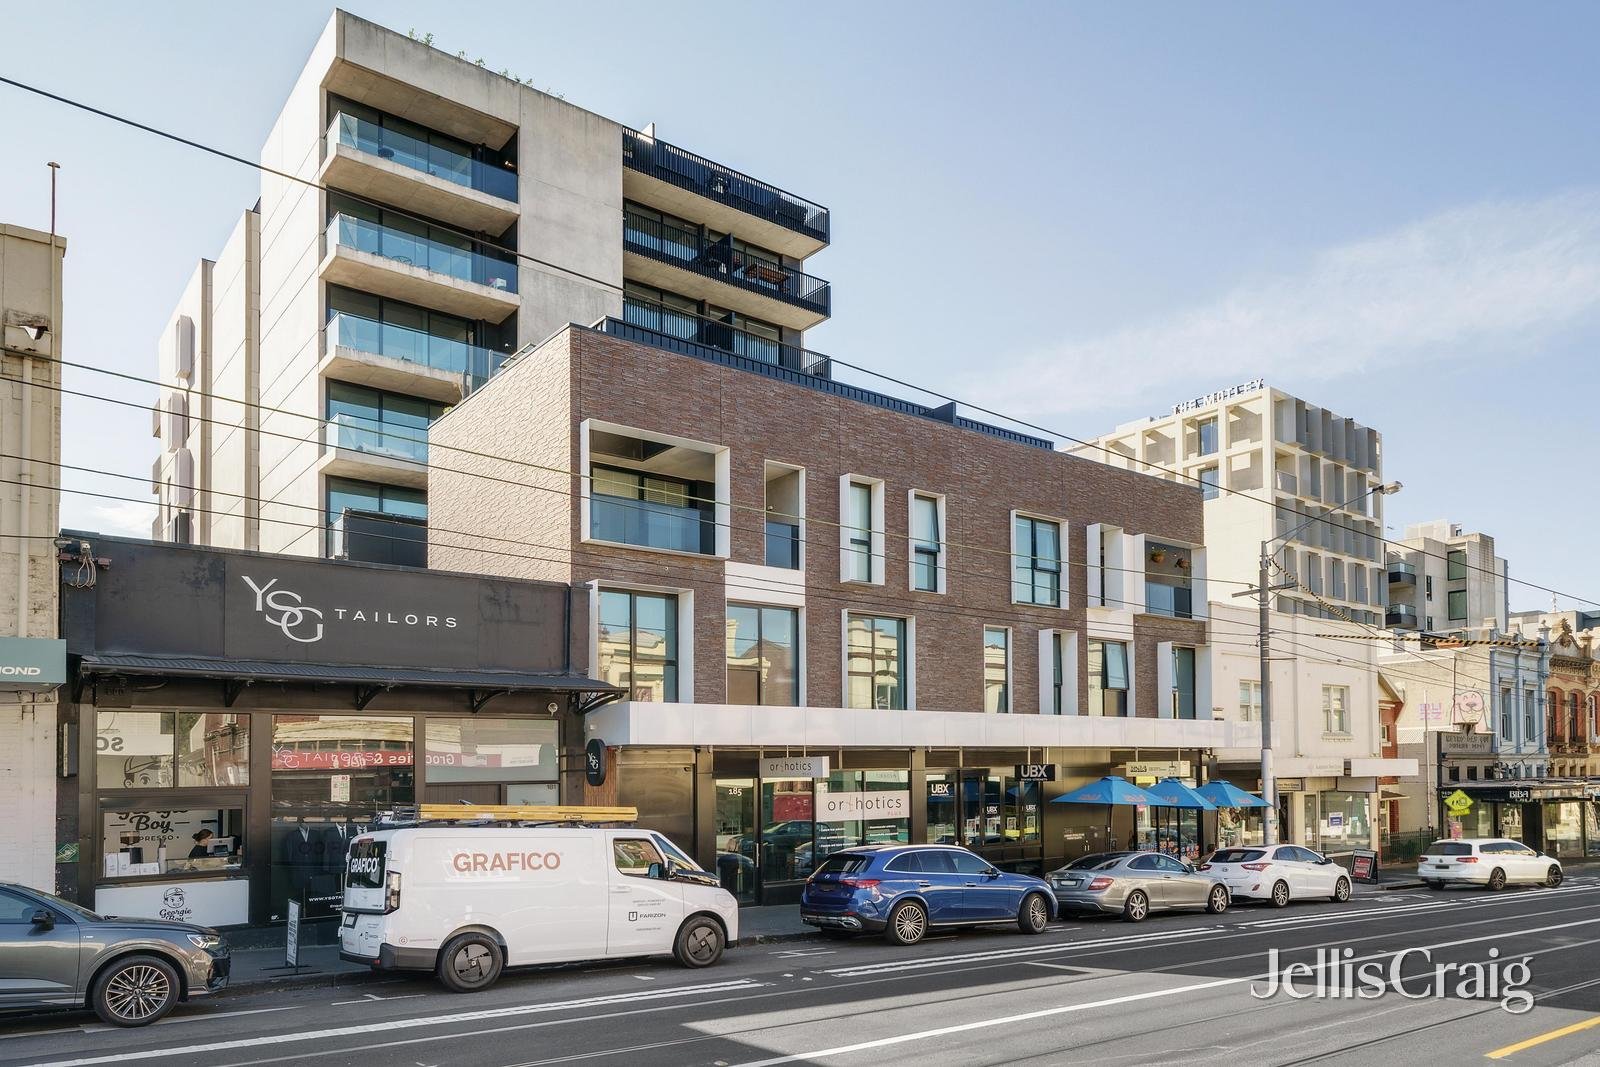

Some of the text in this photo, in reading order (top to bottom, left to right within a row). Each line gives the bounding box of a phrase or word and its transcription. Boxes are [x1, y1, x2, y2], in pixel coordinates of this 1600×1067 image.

[241, 575, 457, 643] YSG TAILORS
[0, 666, 41, 675] OND
[1021, 764, 1048, 778] UBX
[728, 787, 742, 797] 185
[931, 784, 949, 793] UBX
[986, 806, 998, 814] UBX
[129, 814, 174, 833] Boy
[351, 857, 378, 874] GRAFICO
[453, 852, 561, 872] GRAFICO
[159, 907, 192, 920] Georgie
